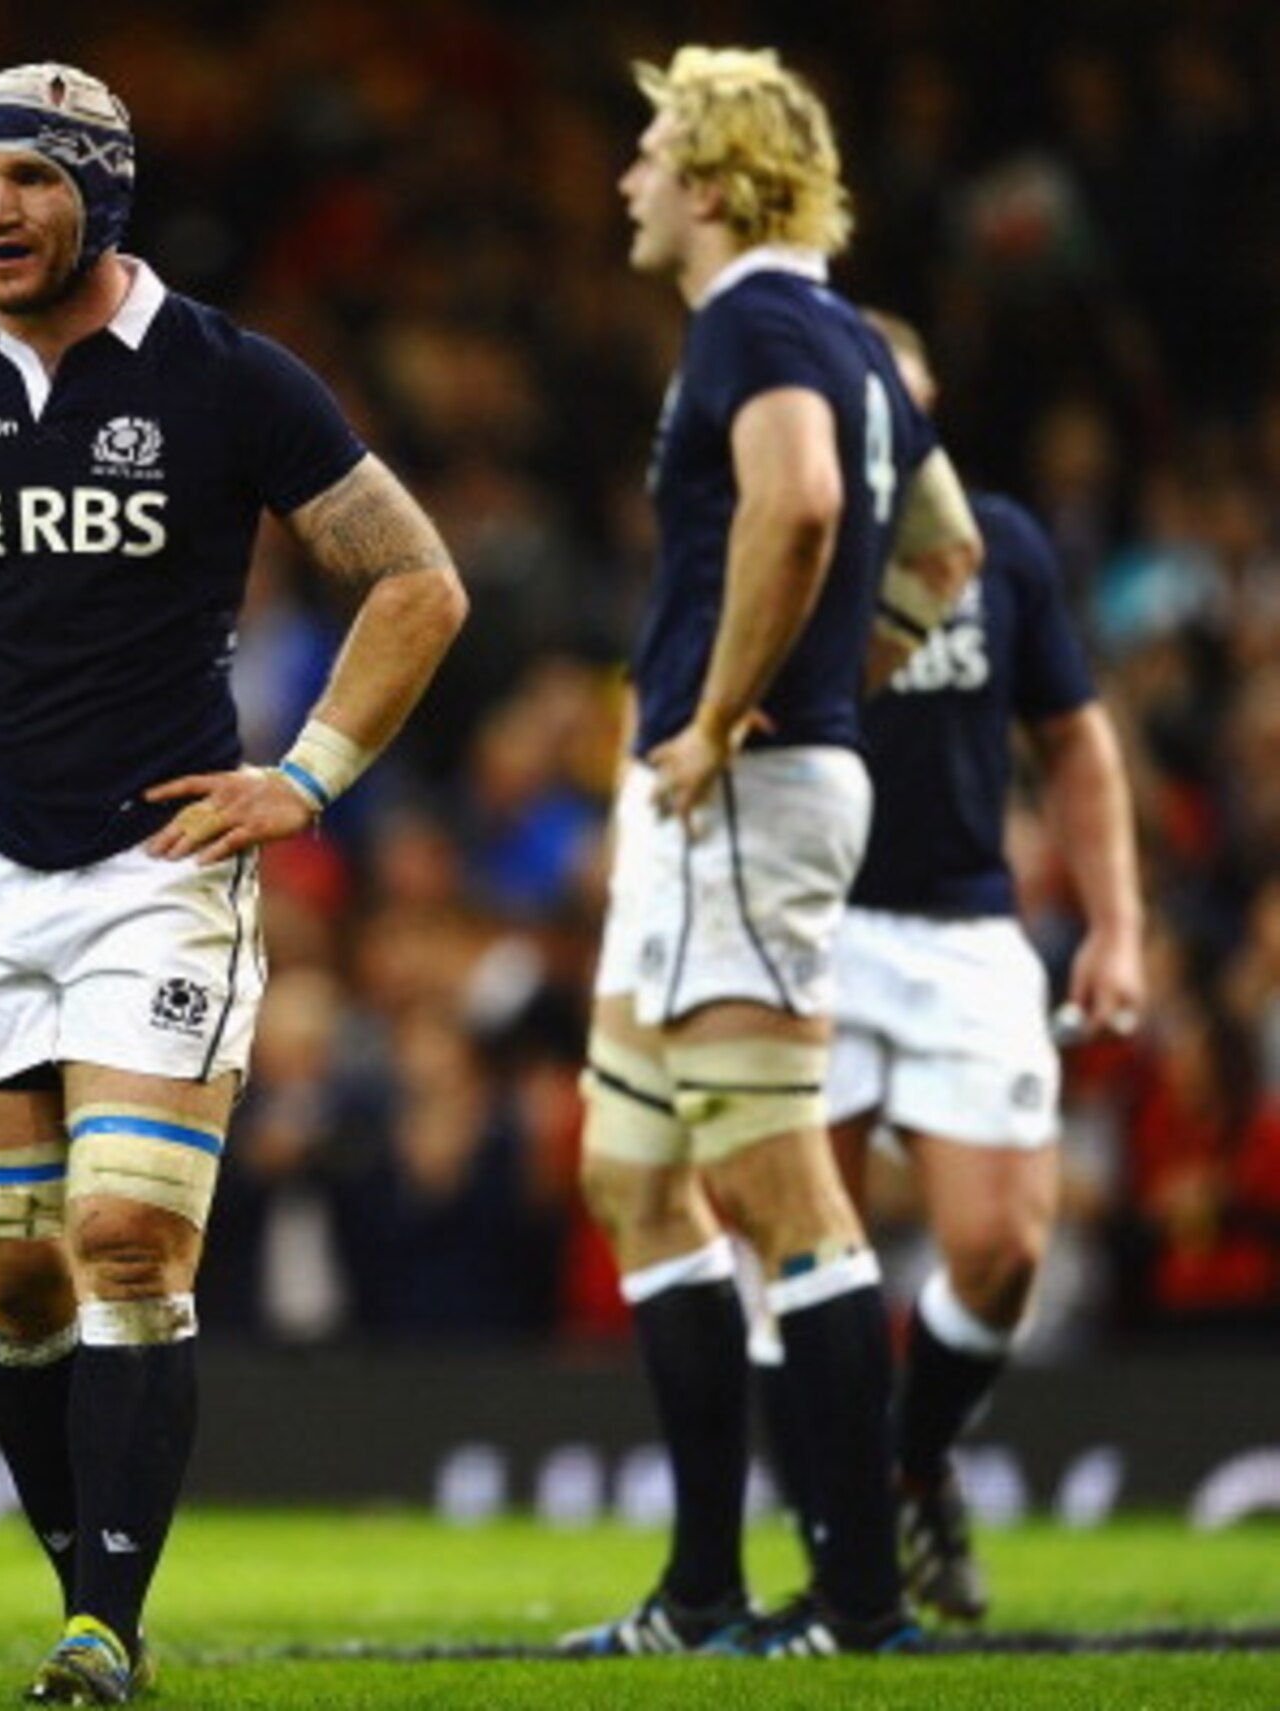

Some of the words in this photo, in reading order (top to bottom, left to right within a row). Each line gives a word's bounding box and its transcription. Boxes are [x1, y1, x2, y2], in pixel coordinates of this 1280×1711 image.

[865, 371, 895, 523] 4
[18, 486, 169, 557] RBS
[892, 625, 989, 691] BS
